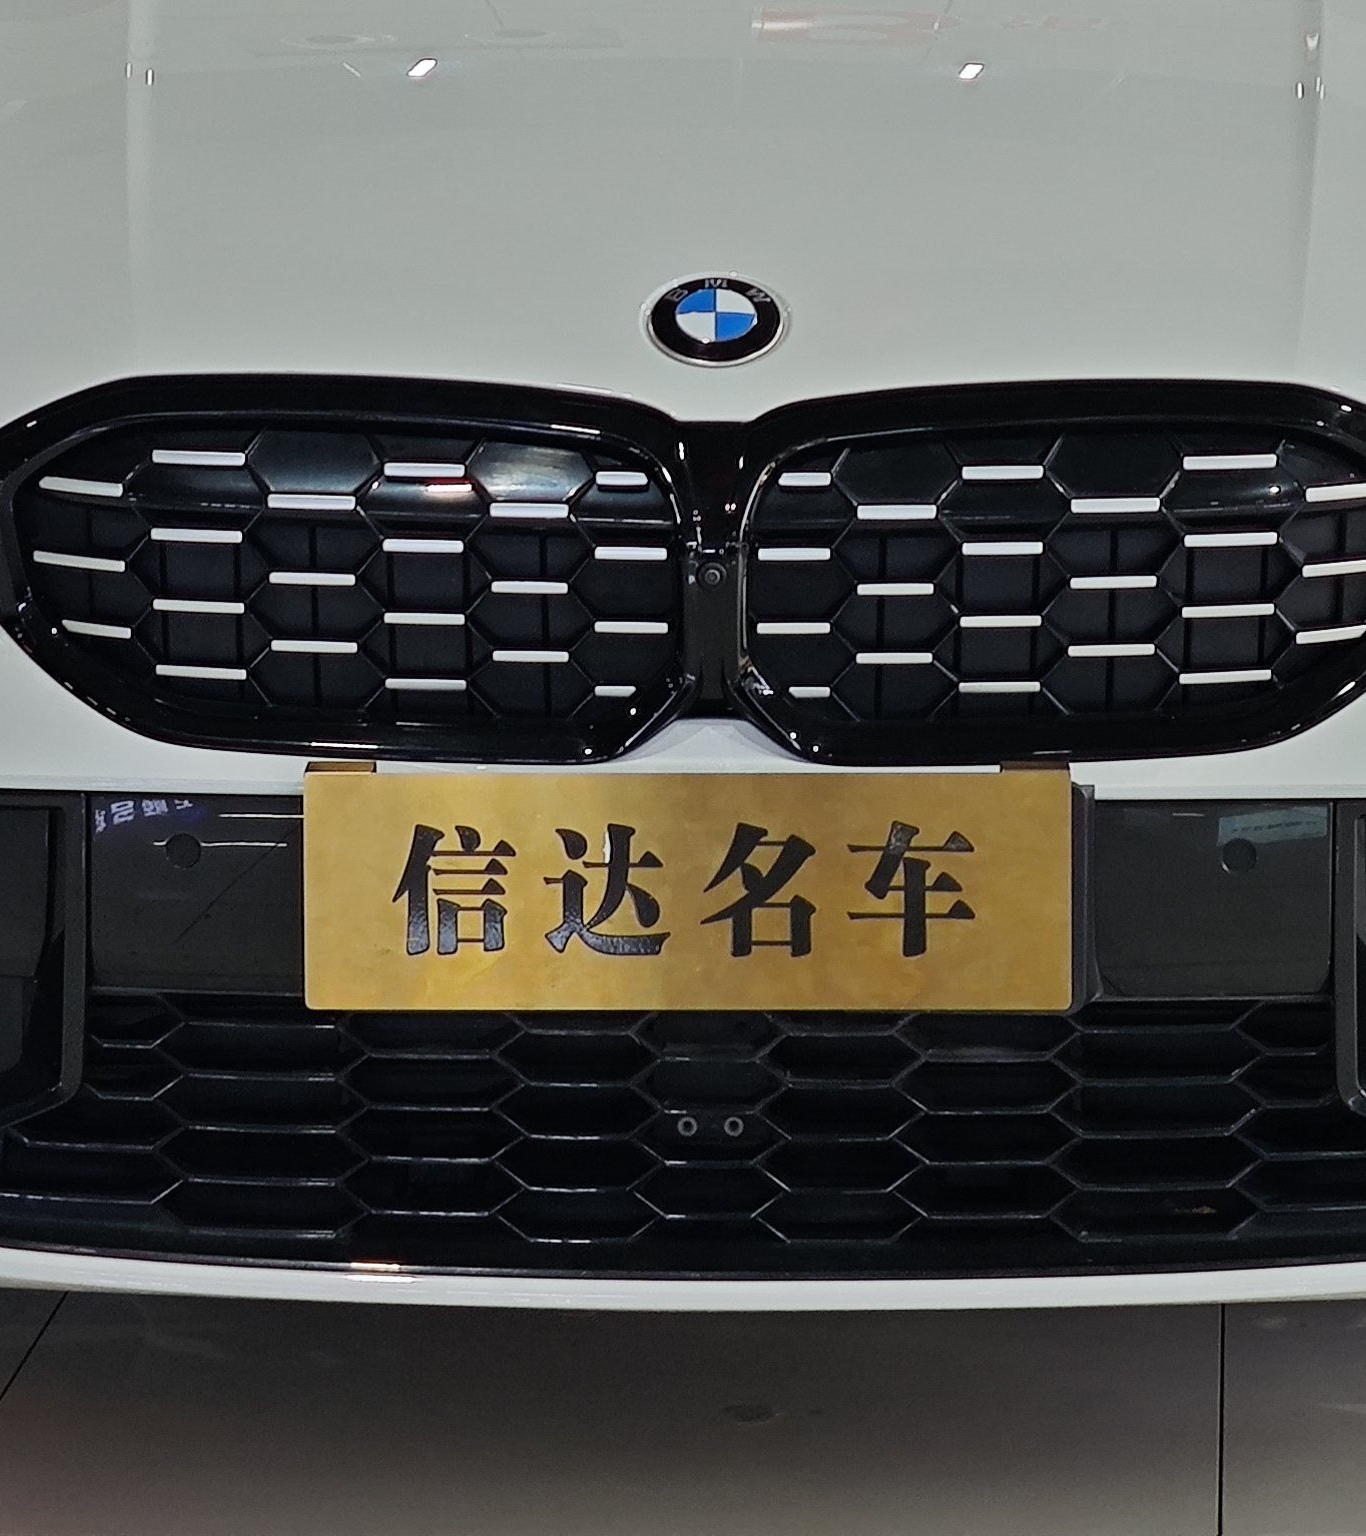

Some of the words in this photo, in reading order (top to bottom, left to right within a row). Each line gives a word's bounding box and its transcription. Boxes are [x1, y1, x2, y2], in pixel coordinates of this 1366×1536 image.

[664, 278, 772, 303] BMW
[390, 820, 979, 960] 信达名车
